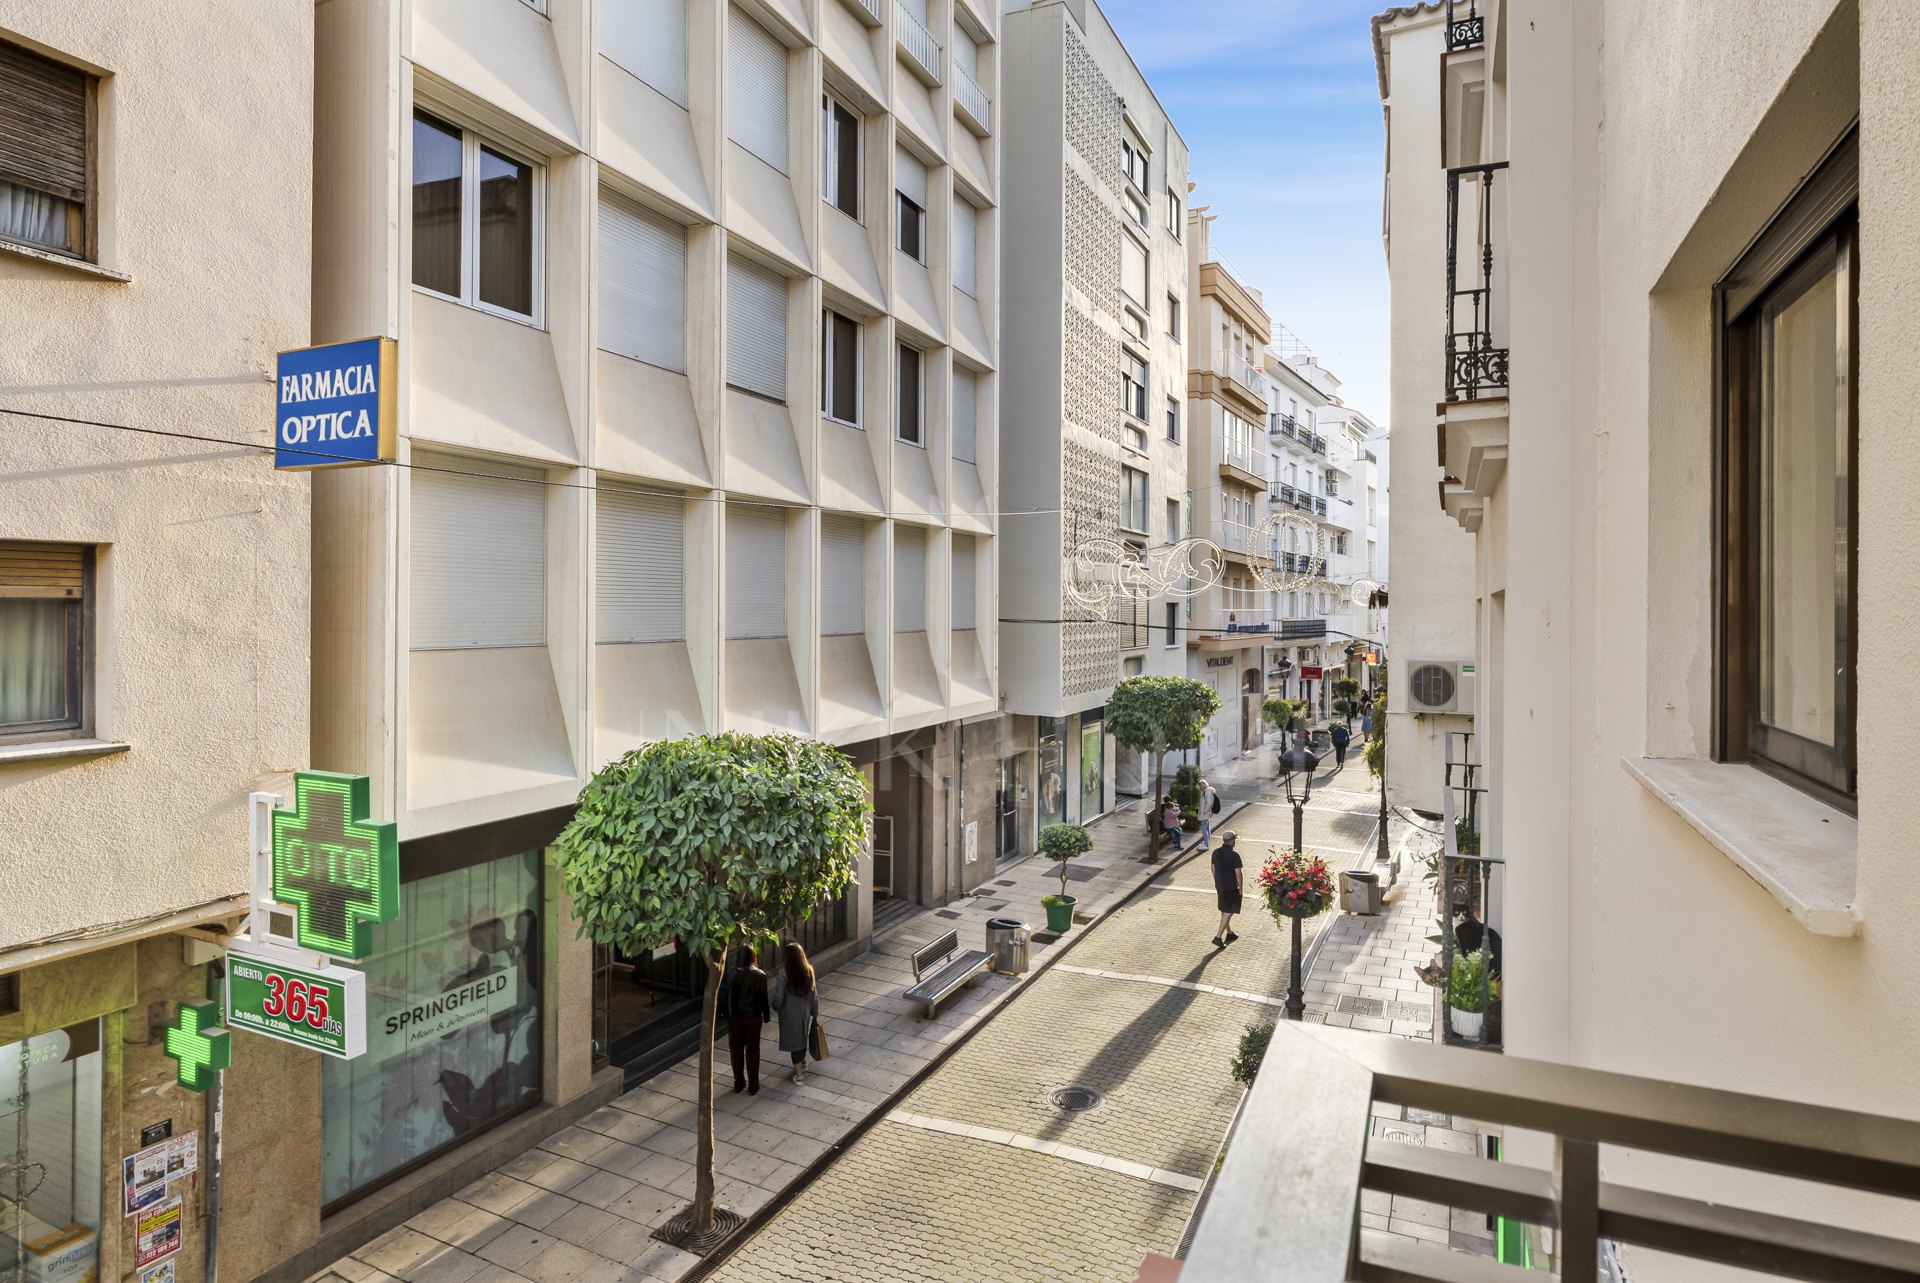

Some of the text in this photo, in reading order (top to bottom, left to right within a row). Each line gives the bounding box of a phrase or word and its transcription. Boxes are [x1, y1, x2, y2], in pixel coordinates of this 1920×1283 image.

[281, 364, 376, 404] FARMACIA
[282, 409, 374, 444] OPTICA
[233, 965, 263, 981] ABIERTO
[235, 1009, 243, 1018] De
[263, 973, 342, 1036] 365 DÍAS
[385, 975, 507, 1035] SPRINGFIELD
[410, 1028, 434, 1042] Man
[436, 1023, 444, 1031] &
